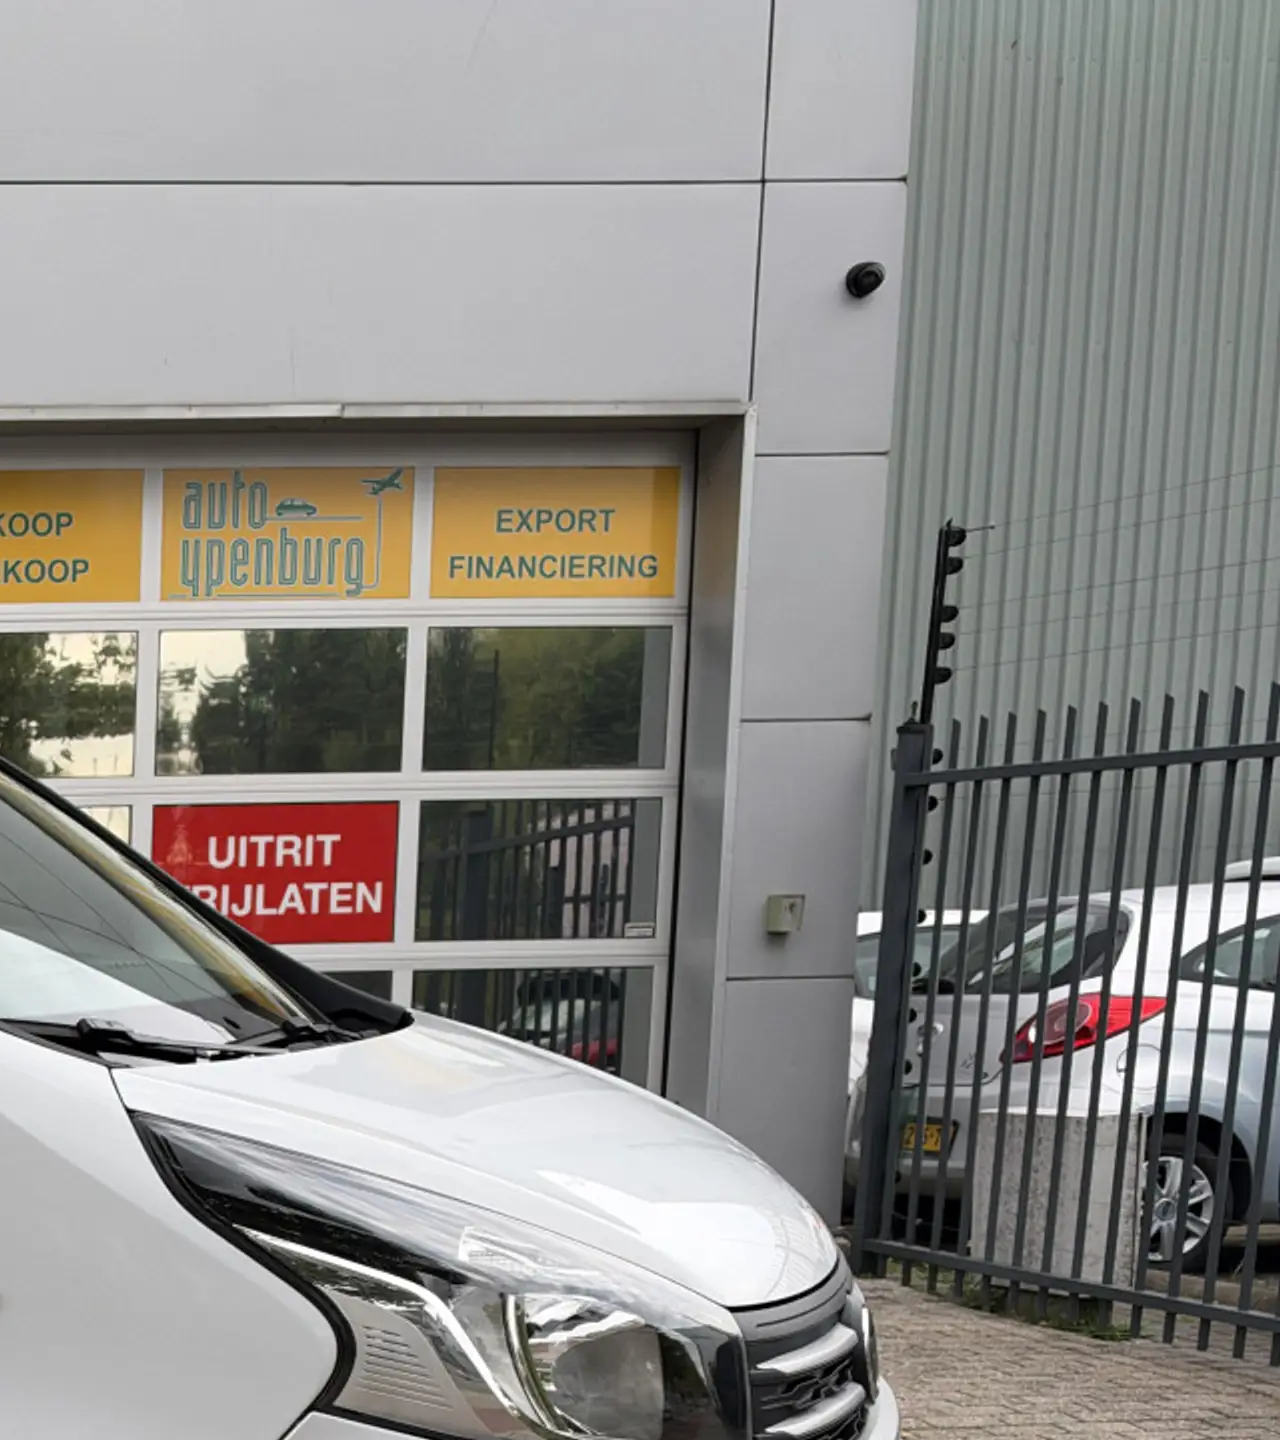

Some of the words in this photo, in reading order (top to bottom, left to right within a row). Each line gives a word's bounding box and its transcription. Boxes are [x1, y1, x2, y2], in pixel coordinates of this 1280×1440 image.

[181, 469, 268, 530] auto
[495, 507, 616, 534] EXPORT
[180, 527, 365, 598] ypenburg
[448, 554, 659, 580] FINANCIERING
[208, 834, 341, 869] UITRIT
[184, 881, 383, 917] RIJLATEN
